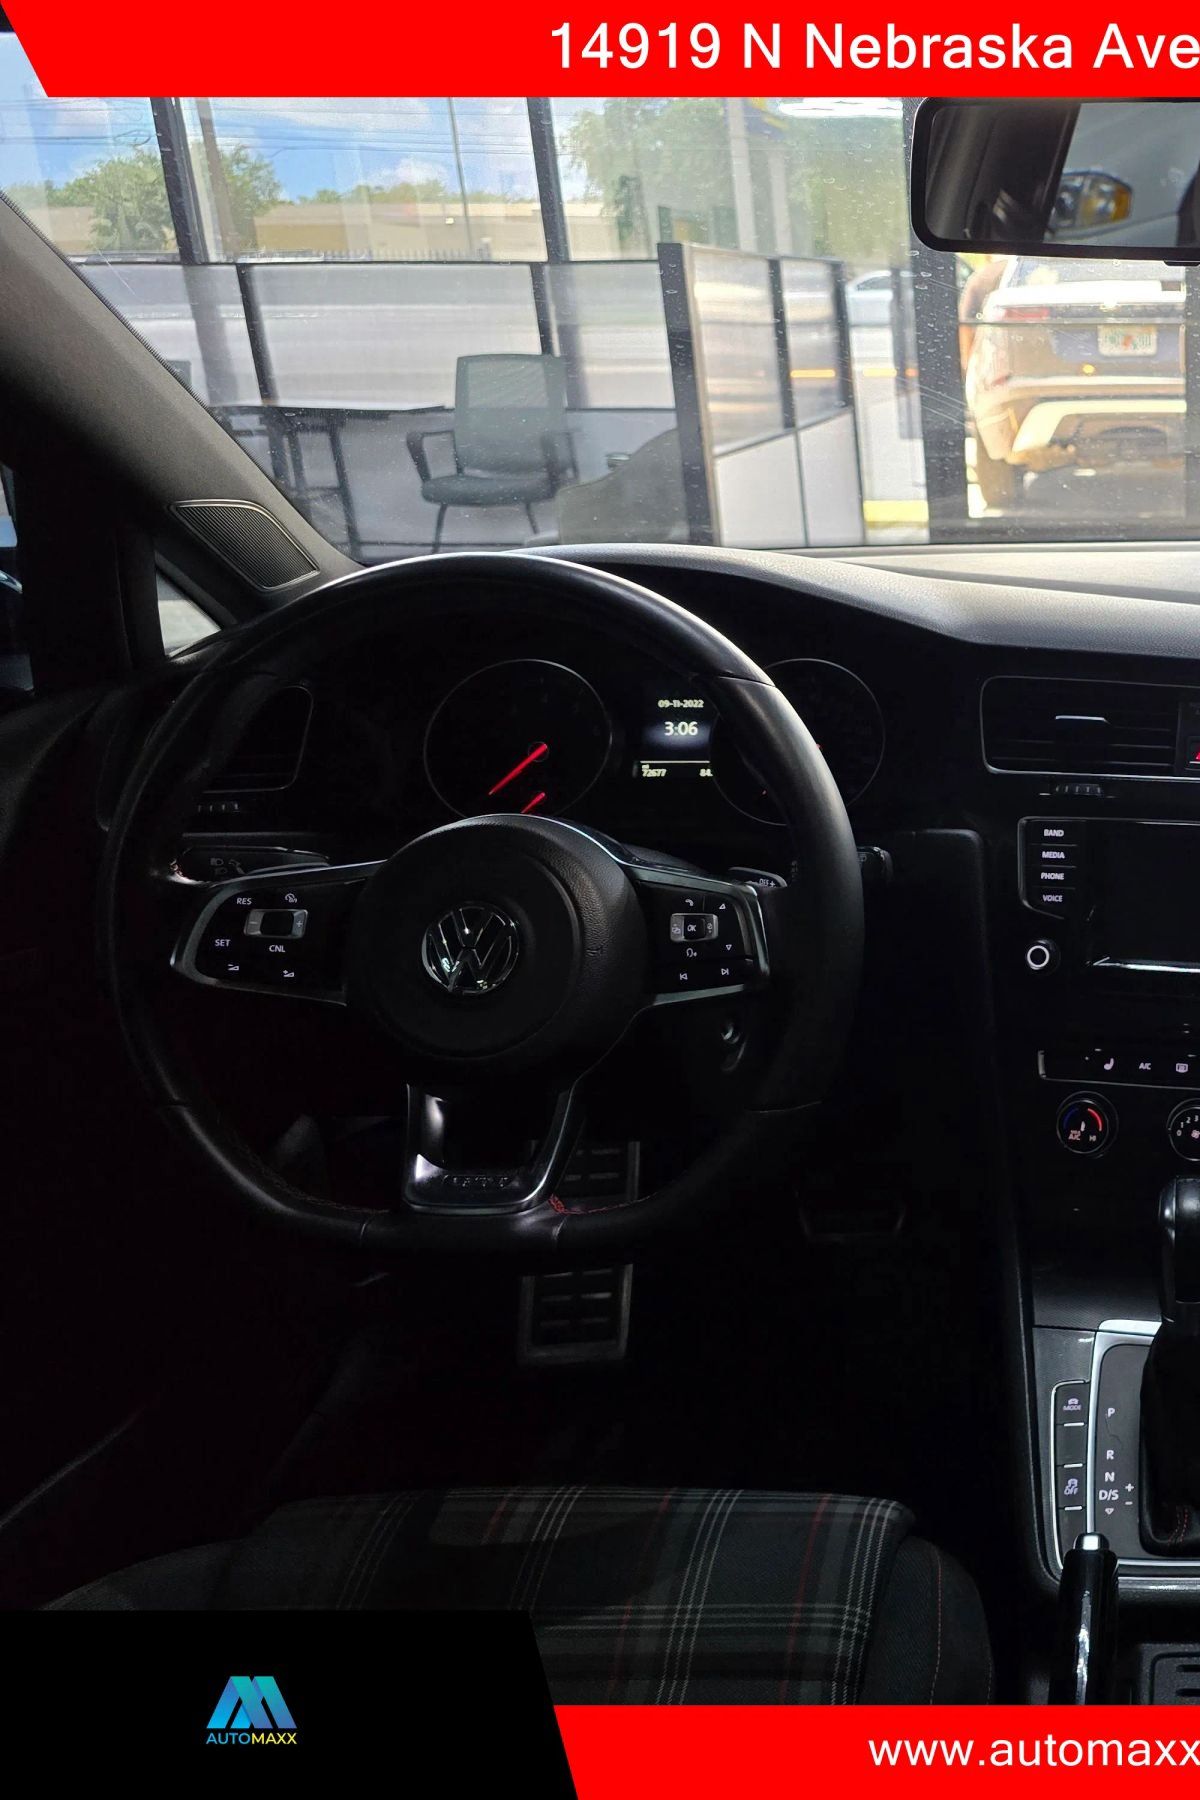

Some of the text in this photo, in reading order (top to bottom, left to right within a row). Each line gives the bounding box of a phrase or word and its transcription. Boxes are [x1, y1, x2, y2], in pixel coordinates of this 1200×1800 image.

[664, 721, 699, 736] 3:06
[1043, 829, 1065, 837] BAND
[1041, 851, 1066, 860] MEDIA
[1040, 872, 1065, 880] PHONE
[236, 897, 252, 906] RES
[1042, 894, 1064, 903] VOICE
[686, 924, 697, 932] OK
[214, 938, 232, 947] SET
[268, 944, 286, 954] CNL
[1138, 1062, 1152, 1071] A/C
[1107, 1407, 1116, 1418] P
[1106, 1449, 1115, 1460] R
[1104, 1471, 1115, 1482] N
[1098, 1489, 1120, 1501] D/S
